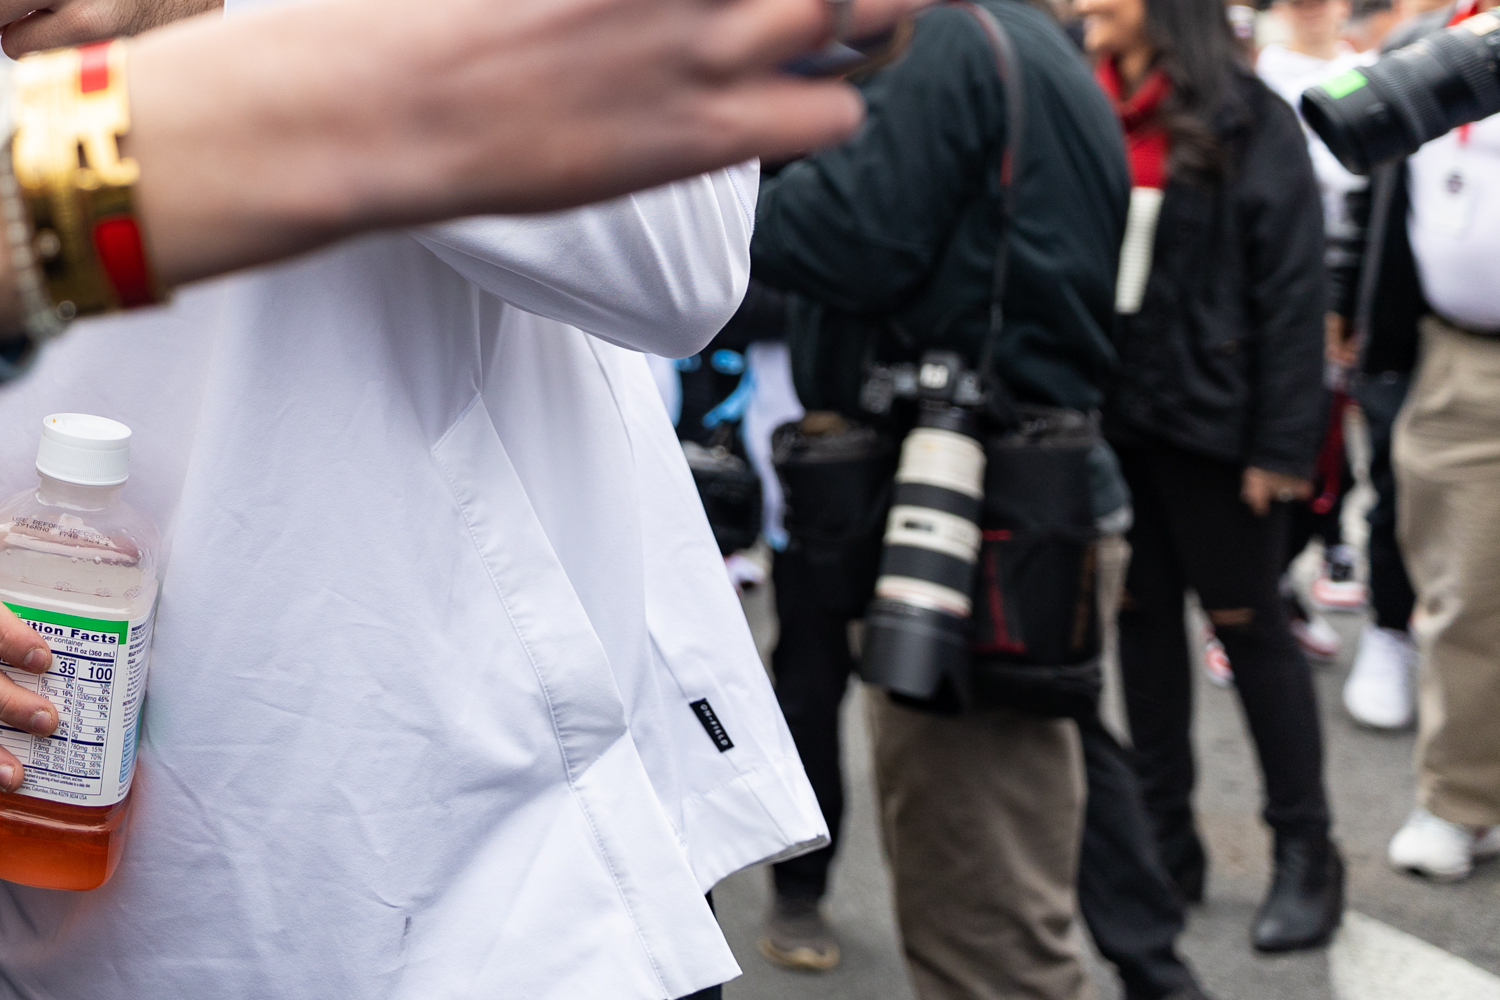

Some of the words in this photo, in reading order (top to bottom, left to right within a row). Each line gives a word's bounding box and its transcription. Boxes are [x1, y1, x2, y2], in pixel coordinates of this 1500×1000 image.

[32, 520, 64, 530] BEFORE
[26, 620, 63, 636] ition
[71, 628, 116, 644] Facts
[54, 637, 84, 647] container
[59, 661, 76, 675] 35
[88, 666, 113, 680] 100
